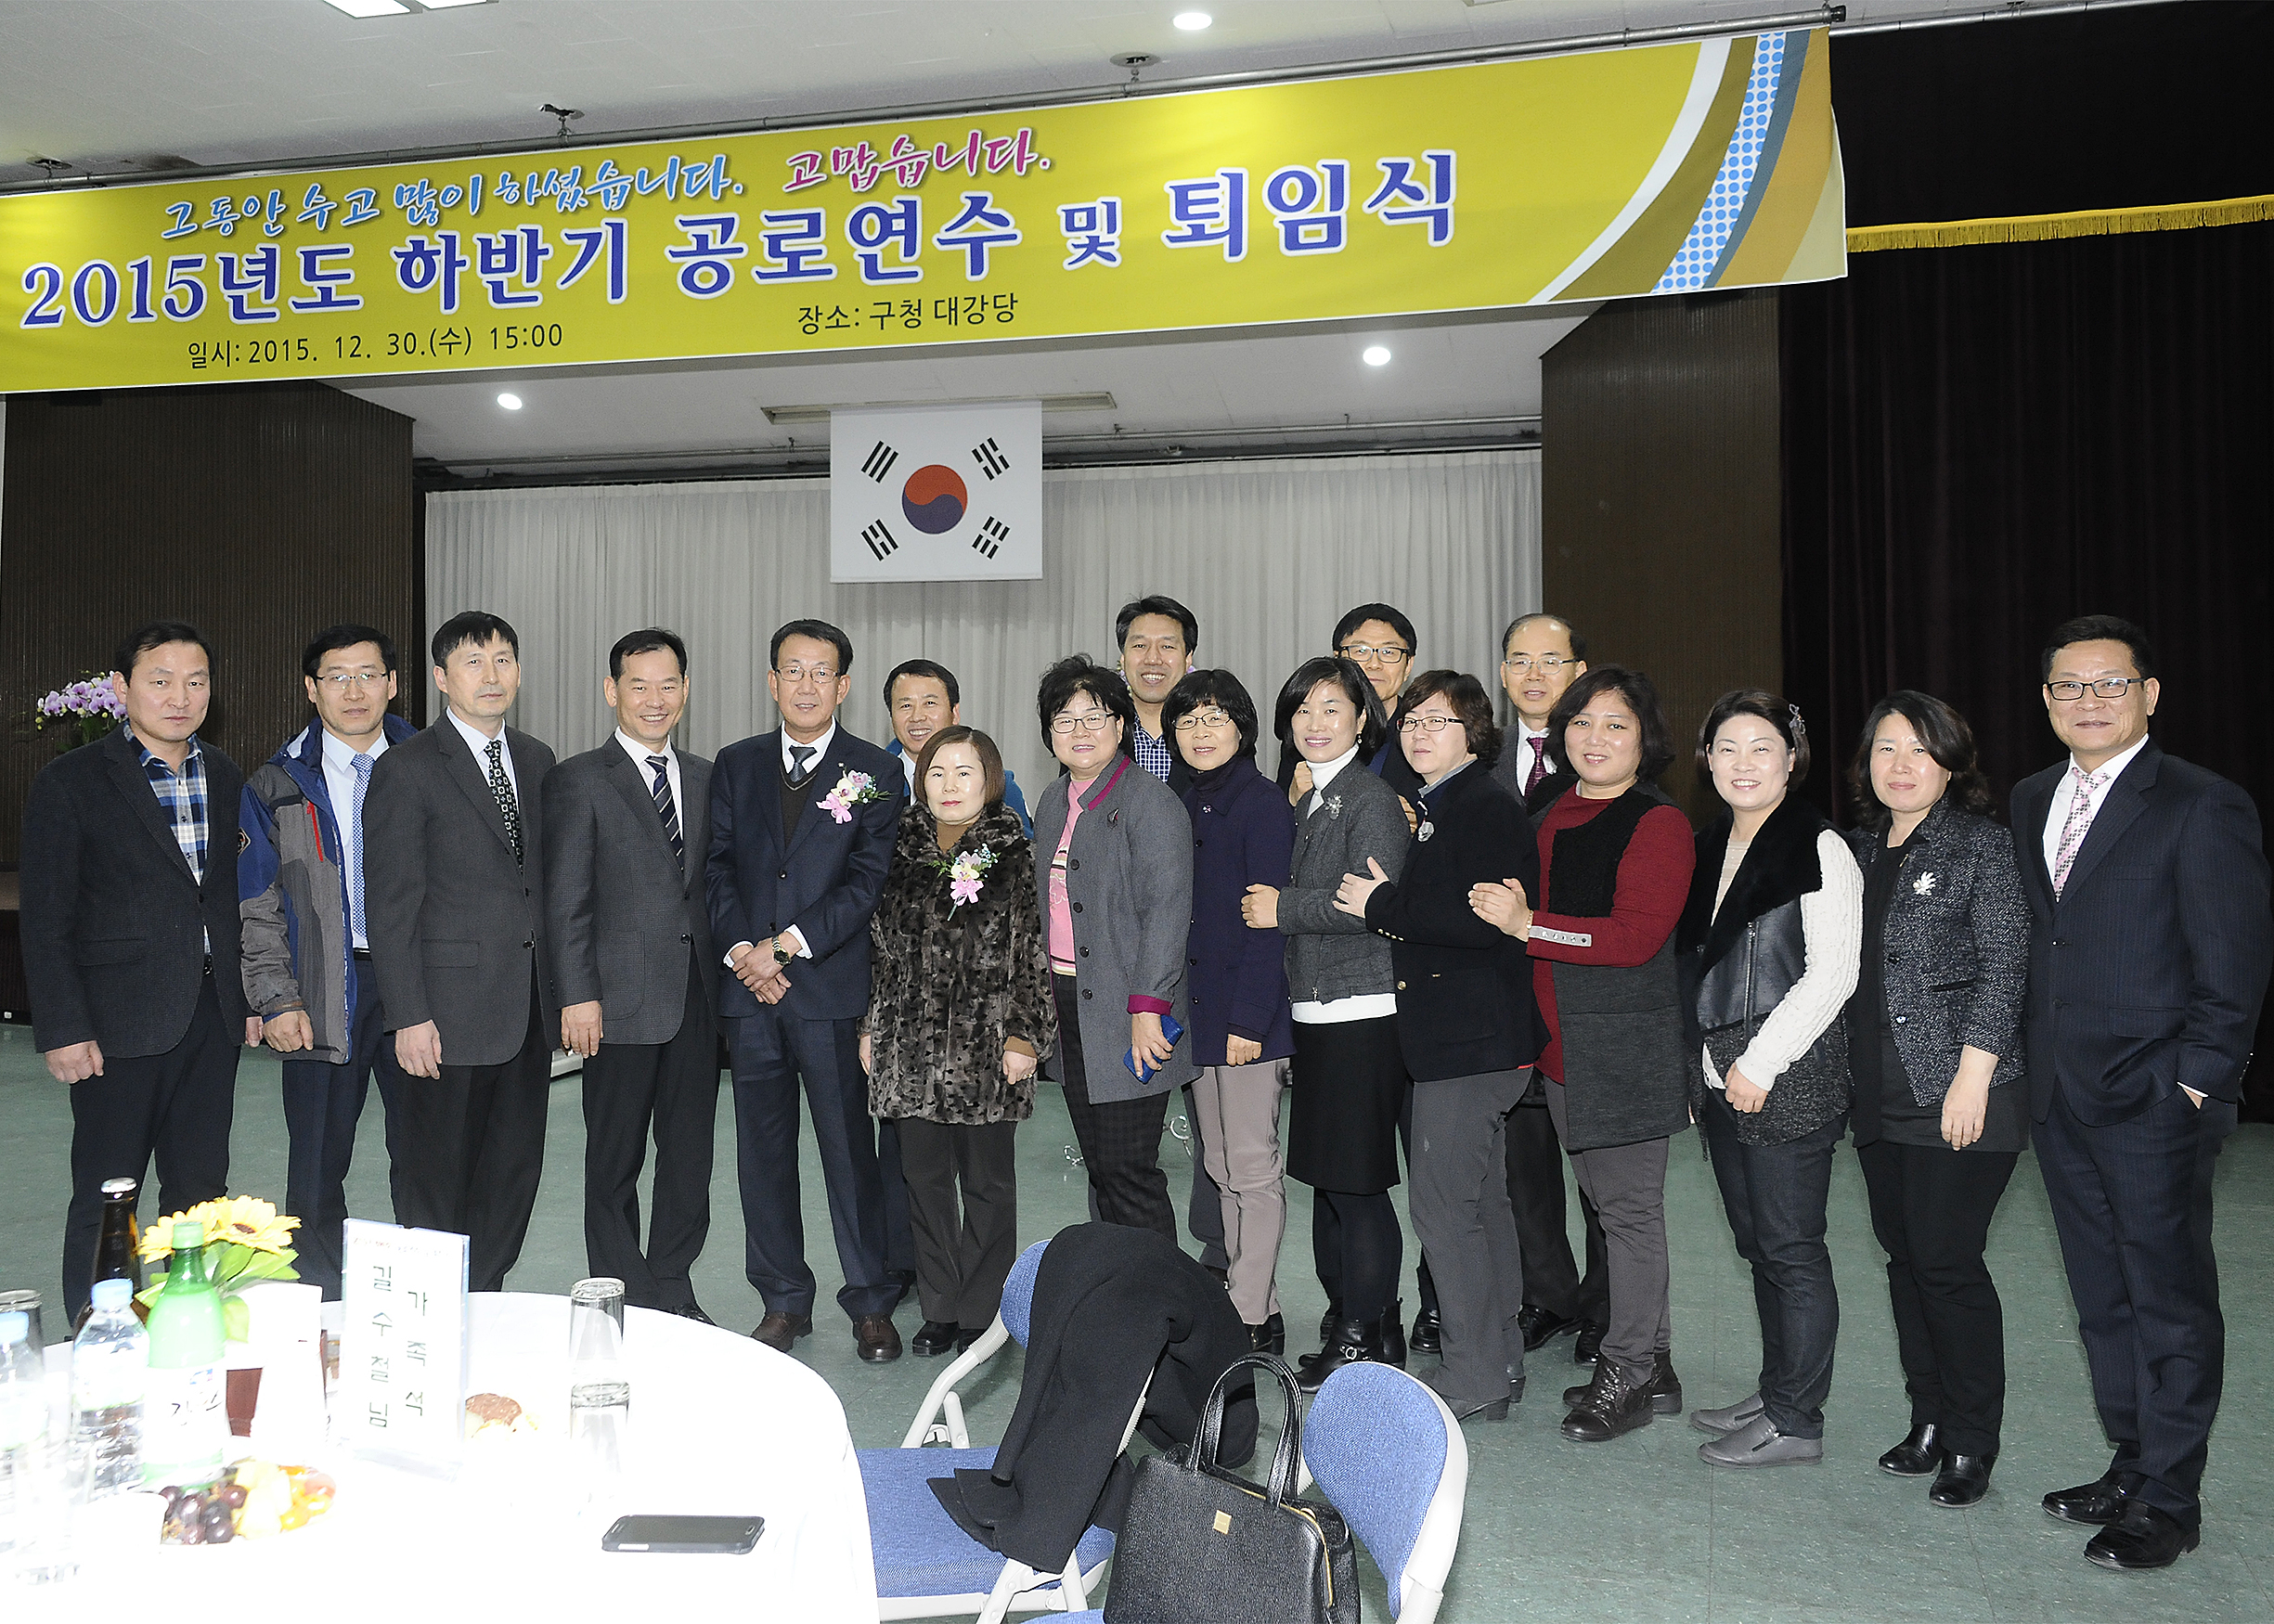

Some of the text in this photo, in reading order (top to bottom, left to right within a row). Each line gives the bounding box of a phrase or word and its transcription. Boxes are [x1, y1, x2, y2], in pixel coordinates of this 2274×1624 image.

[162, 128, 1053, 239] 그동안 수고 많이 하셨습니다. 고맙습니다.
[20, 148, 1457, 328] 2015년도 하반기 공로연수 및 퇴임식
[187, 323, 563, 369] 일시: 2015. 12. 30.(수) 15:00
[797, 291, 1019, 335] 장소: 구청 대강당
